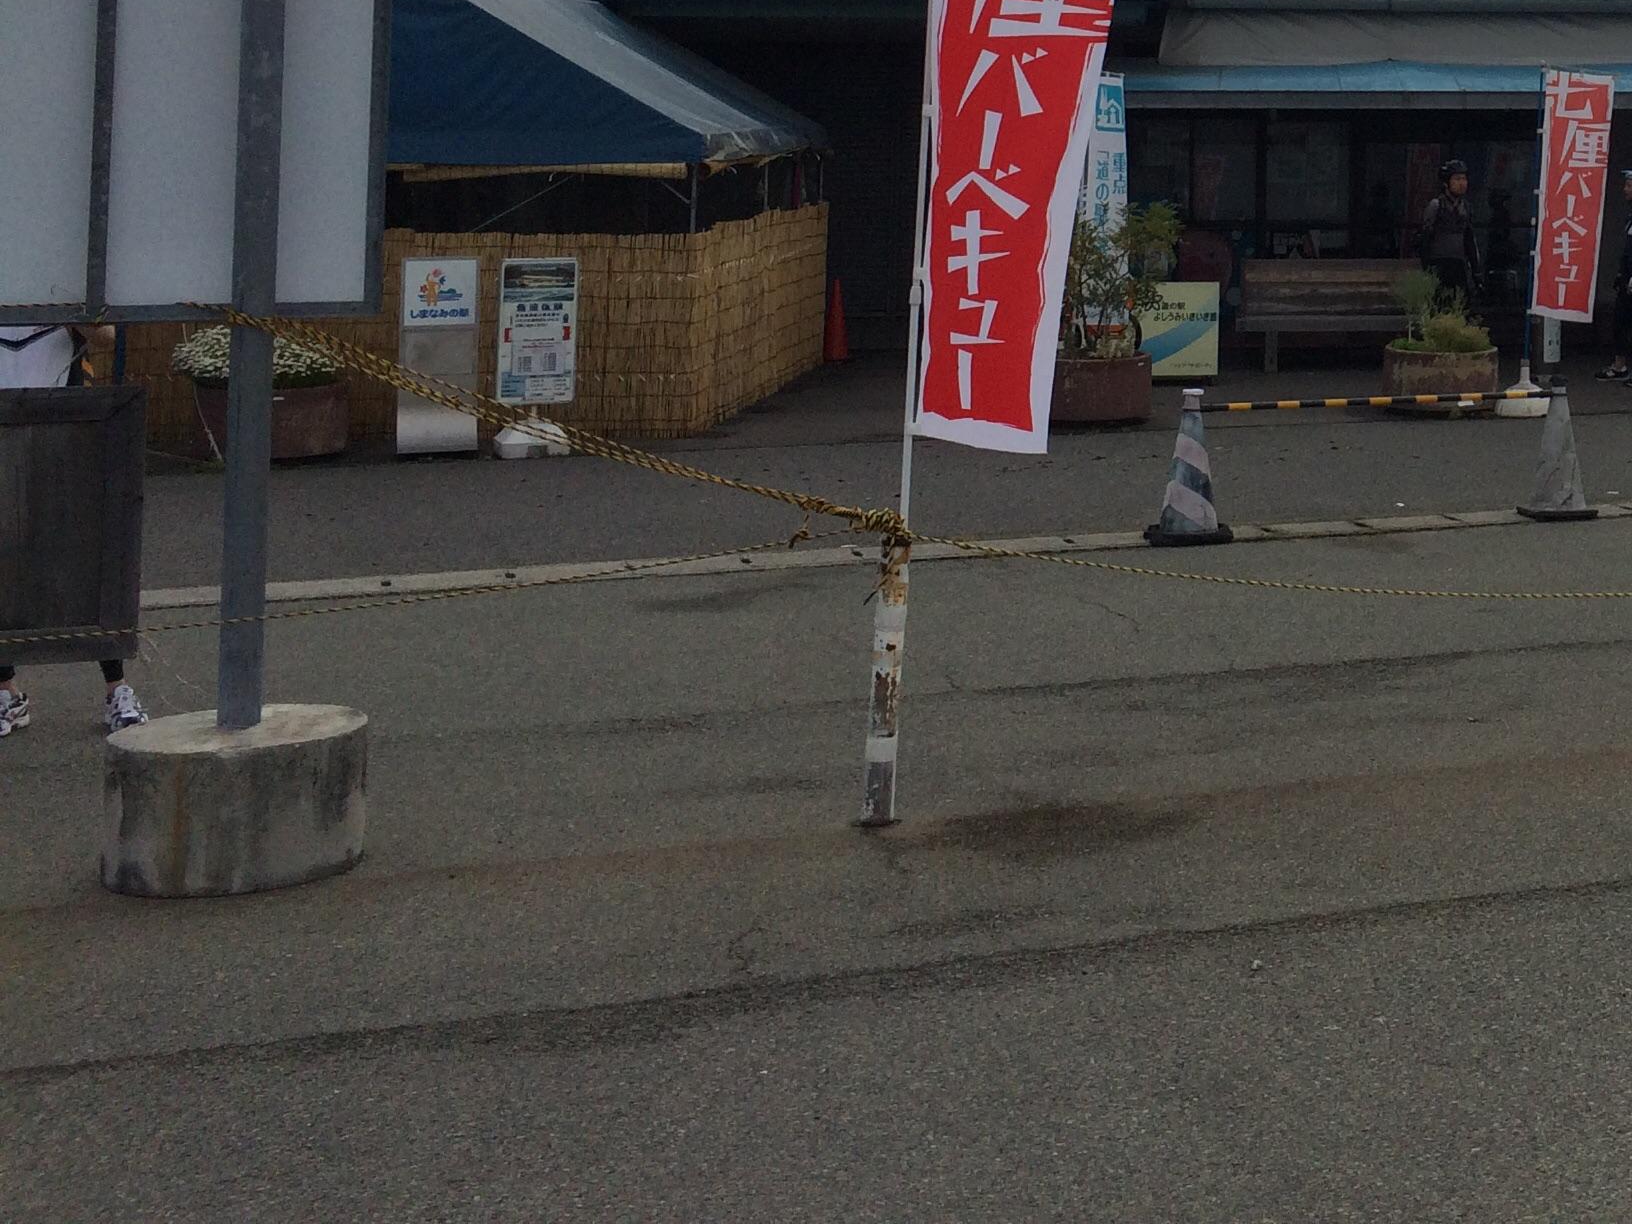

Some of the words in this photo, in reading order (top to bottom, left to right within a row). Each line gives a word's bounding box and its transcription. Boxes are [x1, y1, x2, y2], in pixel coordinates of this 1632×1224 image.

[1112, 152, 1127, 195] 重点
[1546, 72, 1610, 307] 七厘バーベキュー
